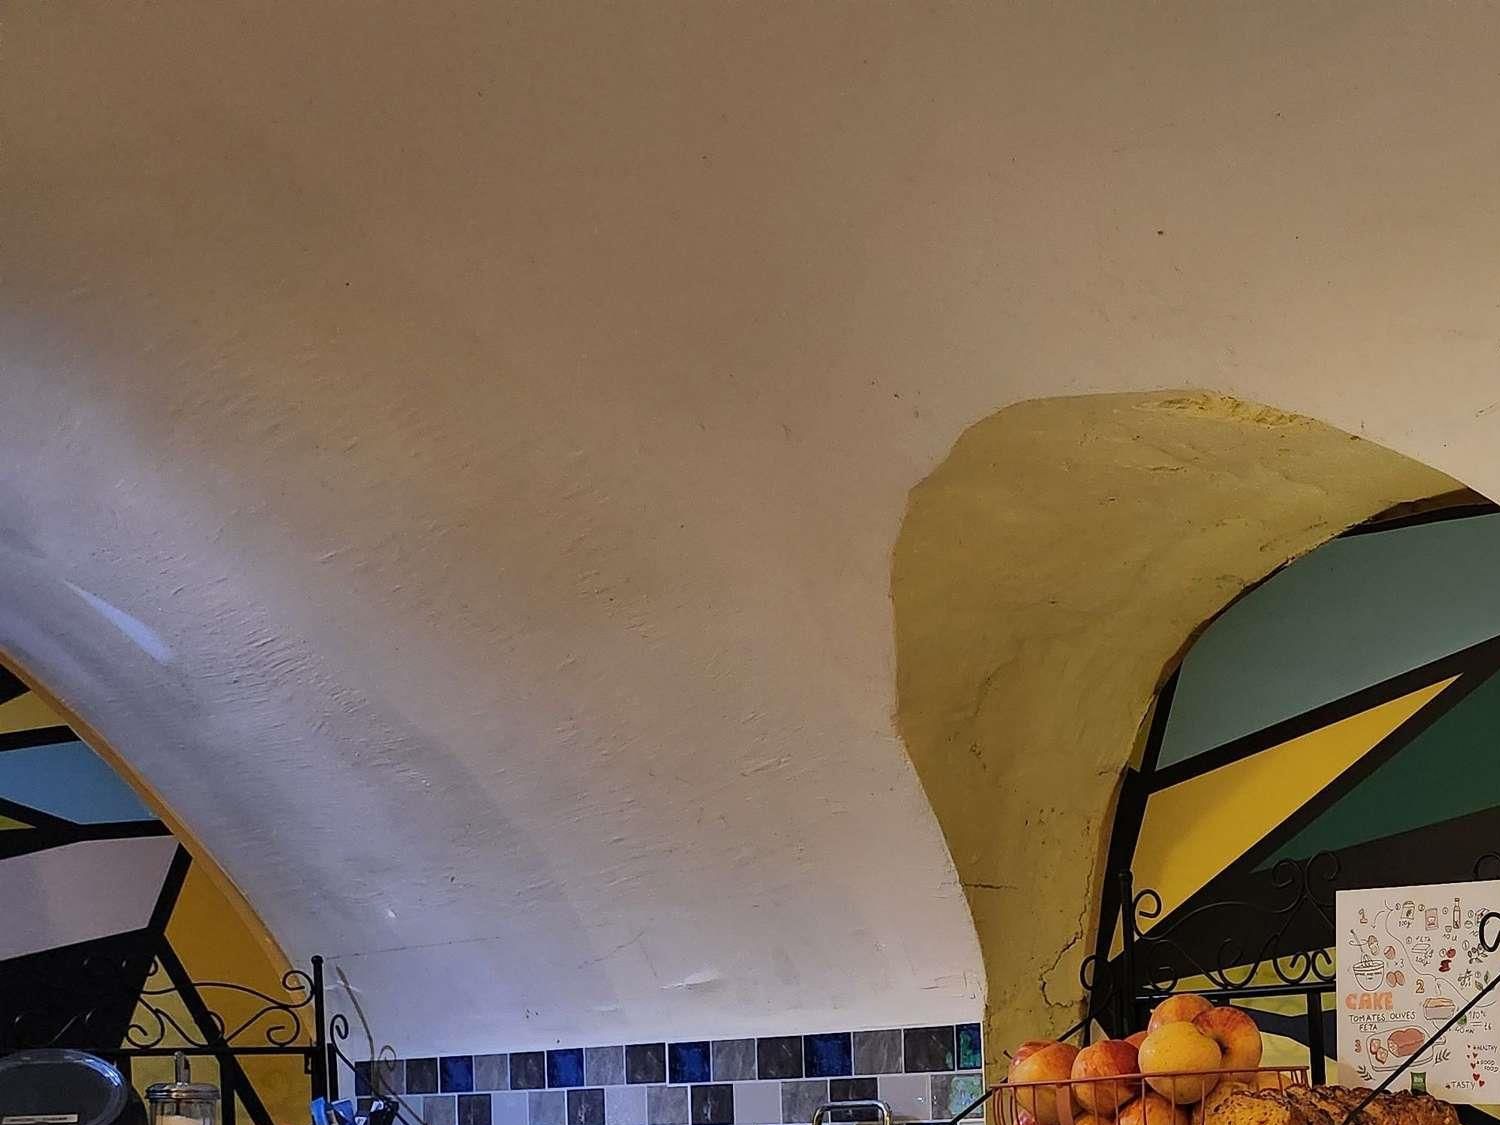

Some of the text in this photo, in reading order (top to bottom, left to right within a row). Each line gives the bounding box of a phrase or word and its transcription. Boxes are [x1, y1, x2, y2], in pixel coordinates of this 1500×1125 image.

[1416, 979, 1424, 993] 2
[1345, 992, 1393, 1010] CAKE
[1349, 1010, 1416, 1022] TOMATES OLIVES
